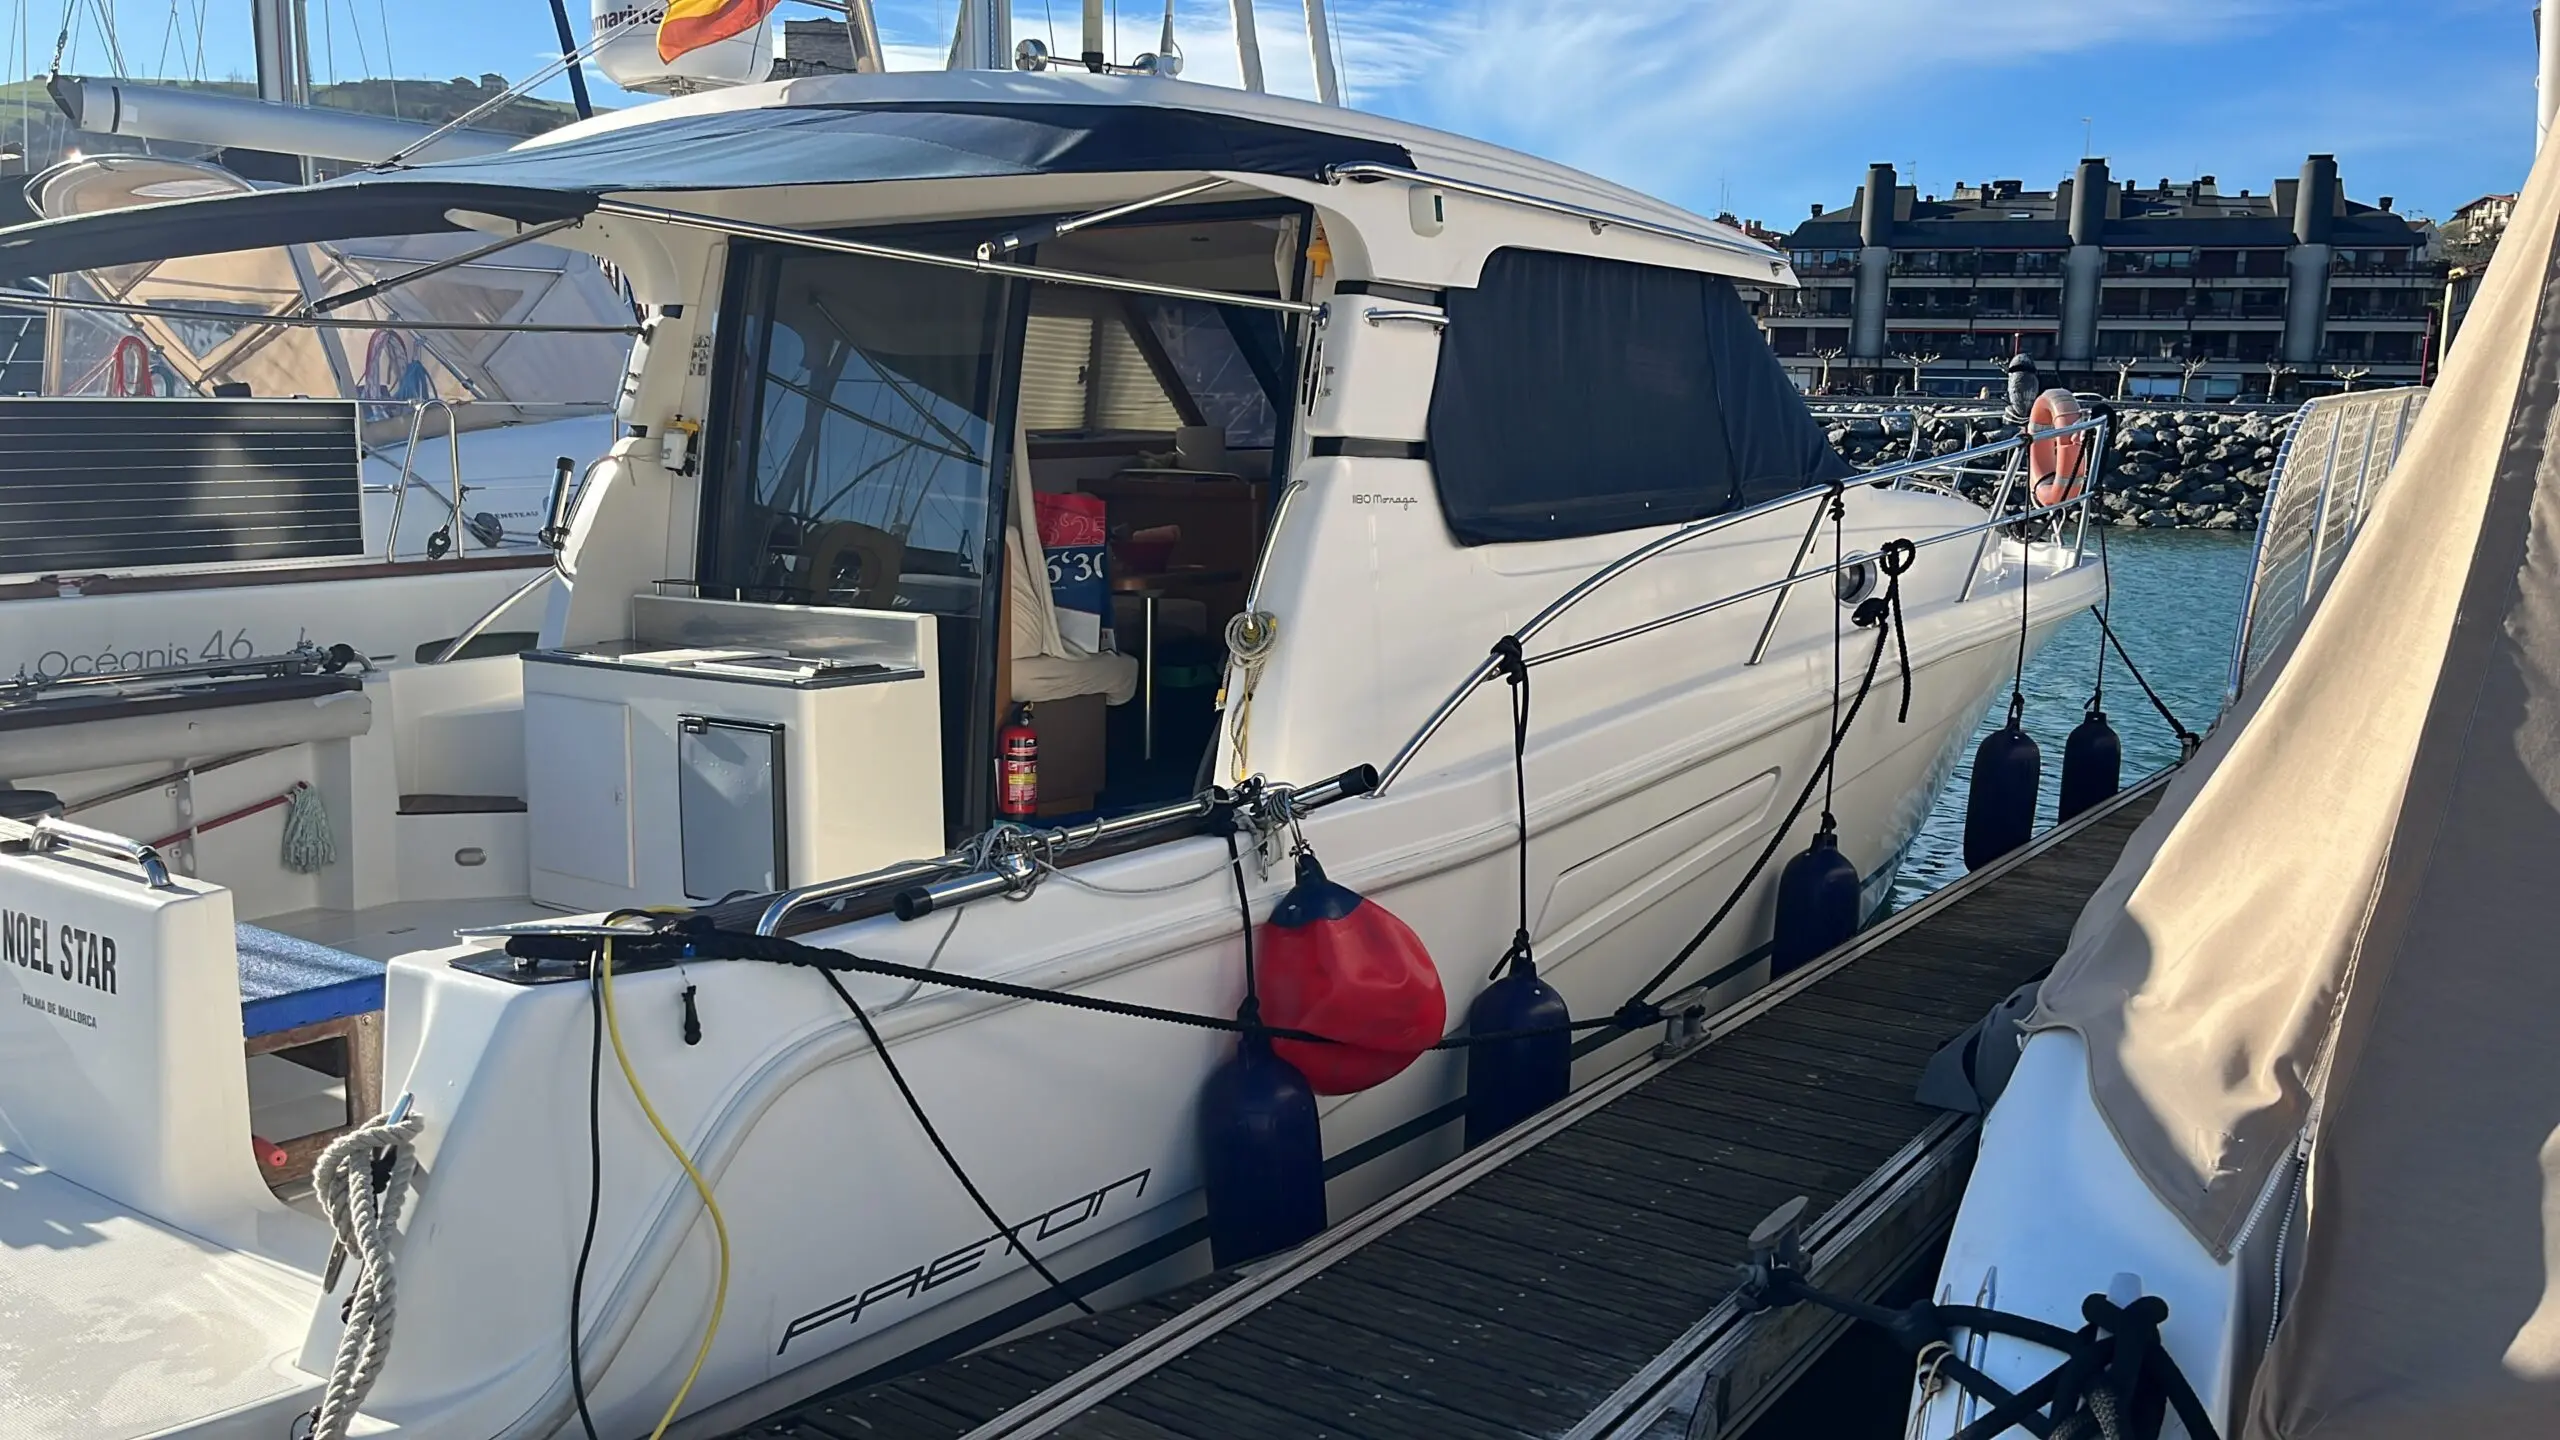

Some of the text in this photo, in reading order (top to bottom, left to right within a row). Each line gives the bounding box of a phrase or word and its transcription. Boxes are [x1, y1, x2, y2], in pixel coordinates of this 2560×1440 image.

[494, 511, 539, 519] ENETEAU
[37, 628, 254, 677] Océanis 46
[2, 908, 117, 995] NOEL STAR
[22, 993, 98, 1029] PALMA DE MALLORCA
[776, 1168, 1150, 1356] FAETON
